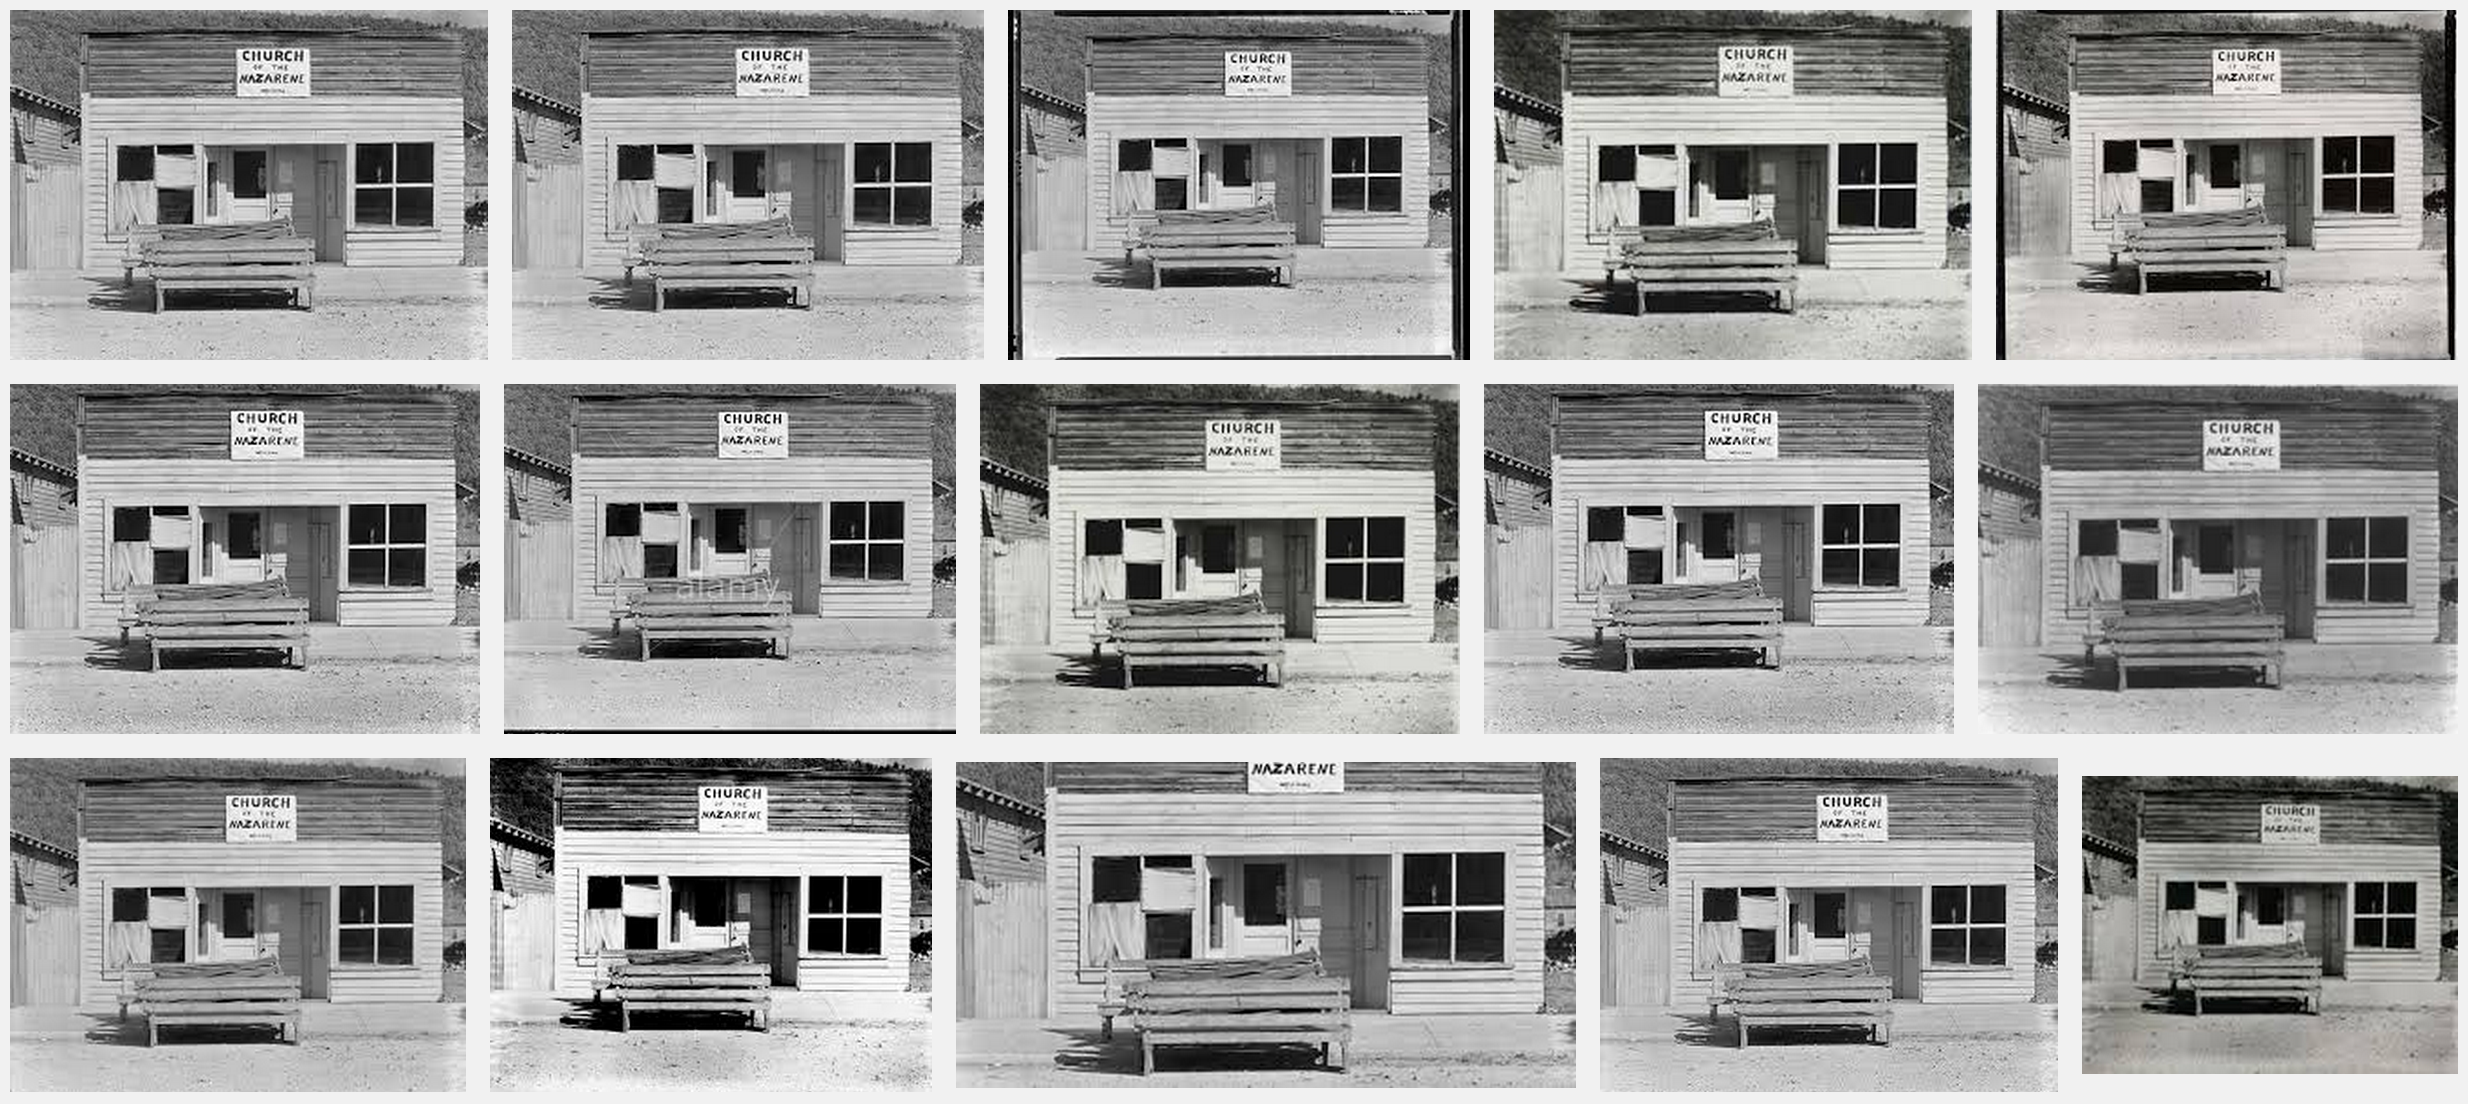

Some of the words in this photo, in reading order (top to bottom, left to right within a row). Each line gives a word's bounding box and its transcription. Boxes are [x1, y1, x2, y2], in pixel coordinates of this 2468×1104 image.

[242, 50, 304, 61] CHURCH
[741, 50, 803, 61] CHURCH
[1230, 54, 1286, 64] CHURCH
[1724, 49, 1787, 60] CHURCH
[2218, 51, 2275, 62] CHURCH
[239, 73, 305, 84] NAZARENE
[738, 73, 803, 84] NAZARENE
[1228, 75, 1287, 84] NAZARENE
[1722, 72, 1787, 83] NAZARENE
[2215, 73, 2276, 82] NAZARENE
[237, 412, 297, 424] CHURCH
[723, 414, 782, 424] CHURCH
[1711, 412, 1772, 424] CHURCH
[1212, 423, 1274, 434] CHURCH
[2209, 423, 2274, 434] CHURCH
[234, 436, 299, 446] NAZARENE
[721, 435, 783, 445] NAZARENE
[1708, 436, 1772, 446] NAZARENE
[2240, 436, 2257, 444] THE
[1208, 446, 1275, 457] NAZARENE
[2206, 446, 2274, 457] NAZARENE
[1251, 763, 1336, 775] NAZARENE
[704, 788, 762, 799] CHURCH
[231, 797, 290, 808] CHURCH
[1822, 797, 1882, 807] CHURCH
[701, 810, 762, 820] NAZARENE
[2265, 806, 2315, 817] CHURCH
[229, 820, 291, 829] NAZARENE
[1819, 818, 1882, 829] NAZARENE
